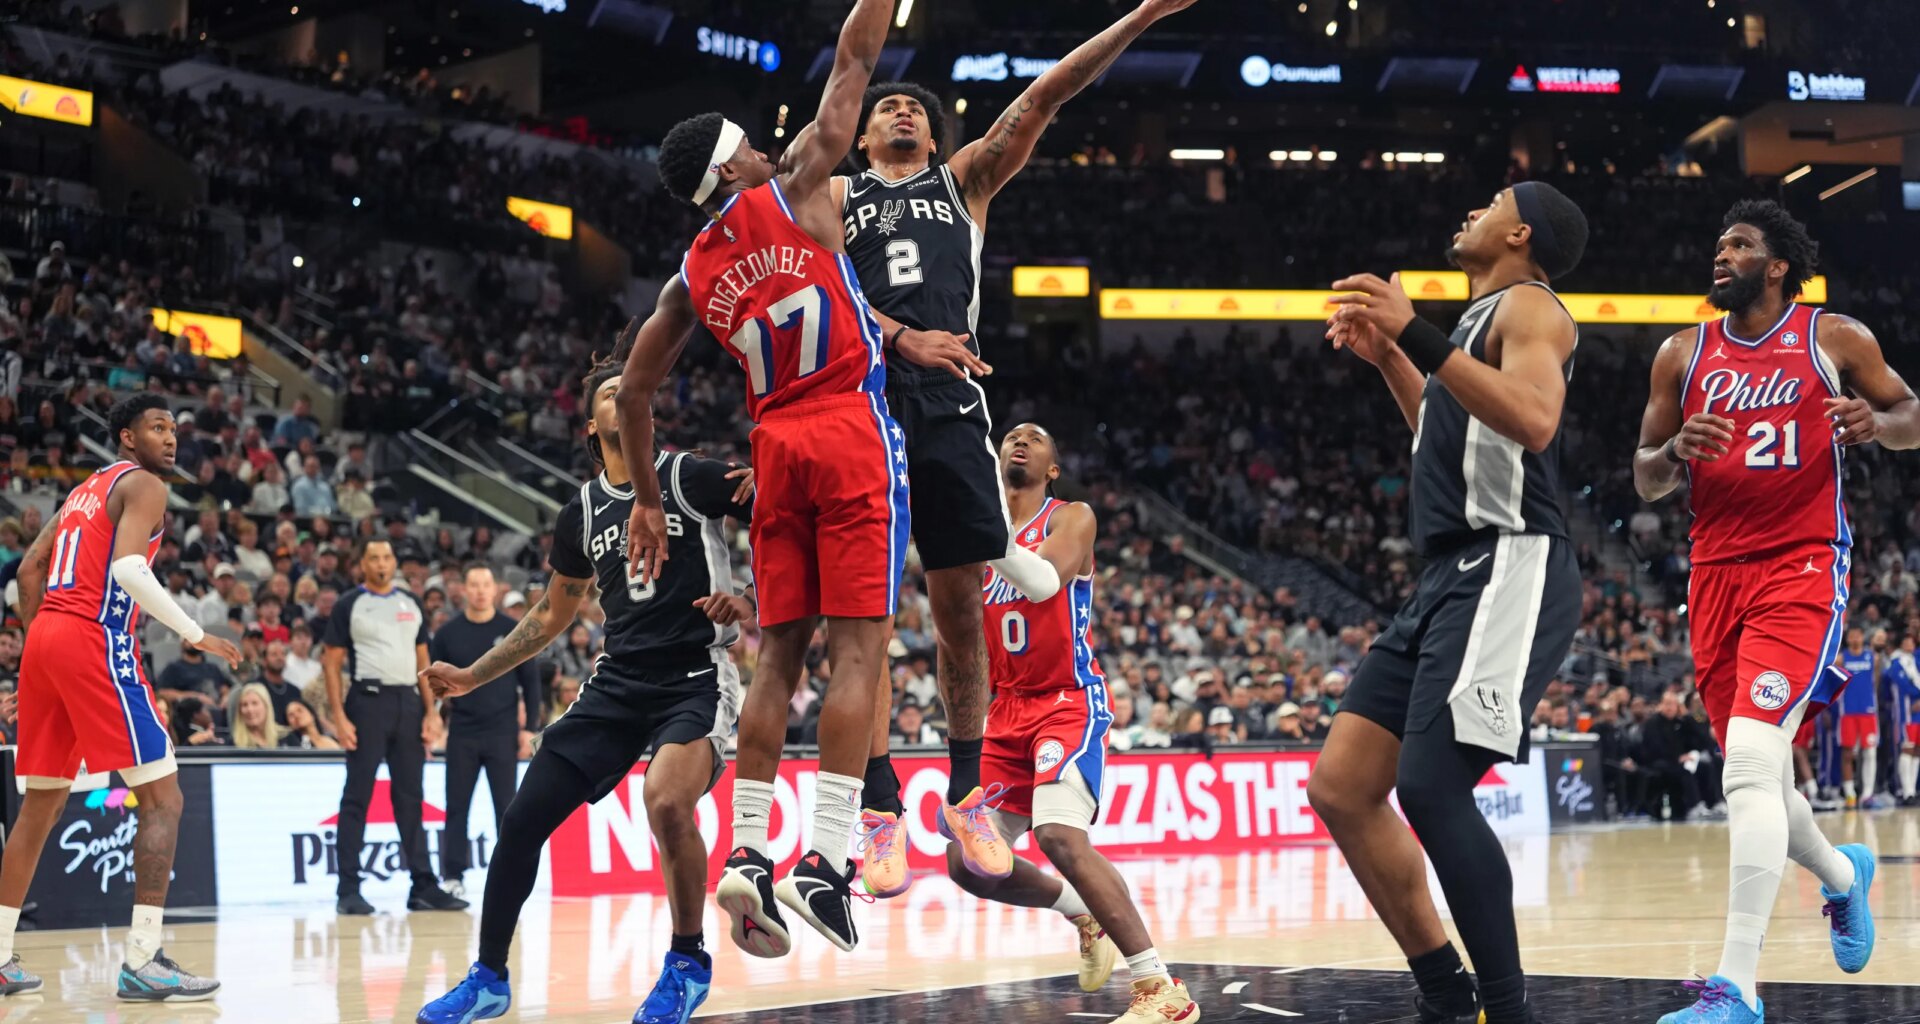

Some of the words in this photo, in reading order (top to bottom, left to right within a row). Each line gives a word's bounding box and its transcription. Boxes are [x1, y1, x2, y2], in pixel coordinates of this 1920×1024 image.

[1537, 67, 1579, 83] WEST
[1580, 68, 1620, 84] LOOP
[844, 199, 954, 246] SPURS
[706, 244, 814, 330] EDGECOMBE
[885, 238, 923, 287] 2
[728, 283, 832, 399] 17
[1701, 368, 1803, 415] Phila
[1745, 420, 1801, 470] 21
[47, 525, 81, 592] 11
[624, 558, 657, 603] 5
[1001, 610, 1030, 656] 0
[1754, 683, 1783, 703] 76ers
[1222, 760, 1314, 838] THE
[291, 831, 411, 884] Piza
